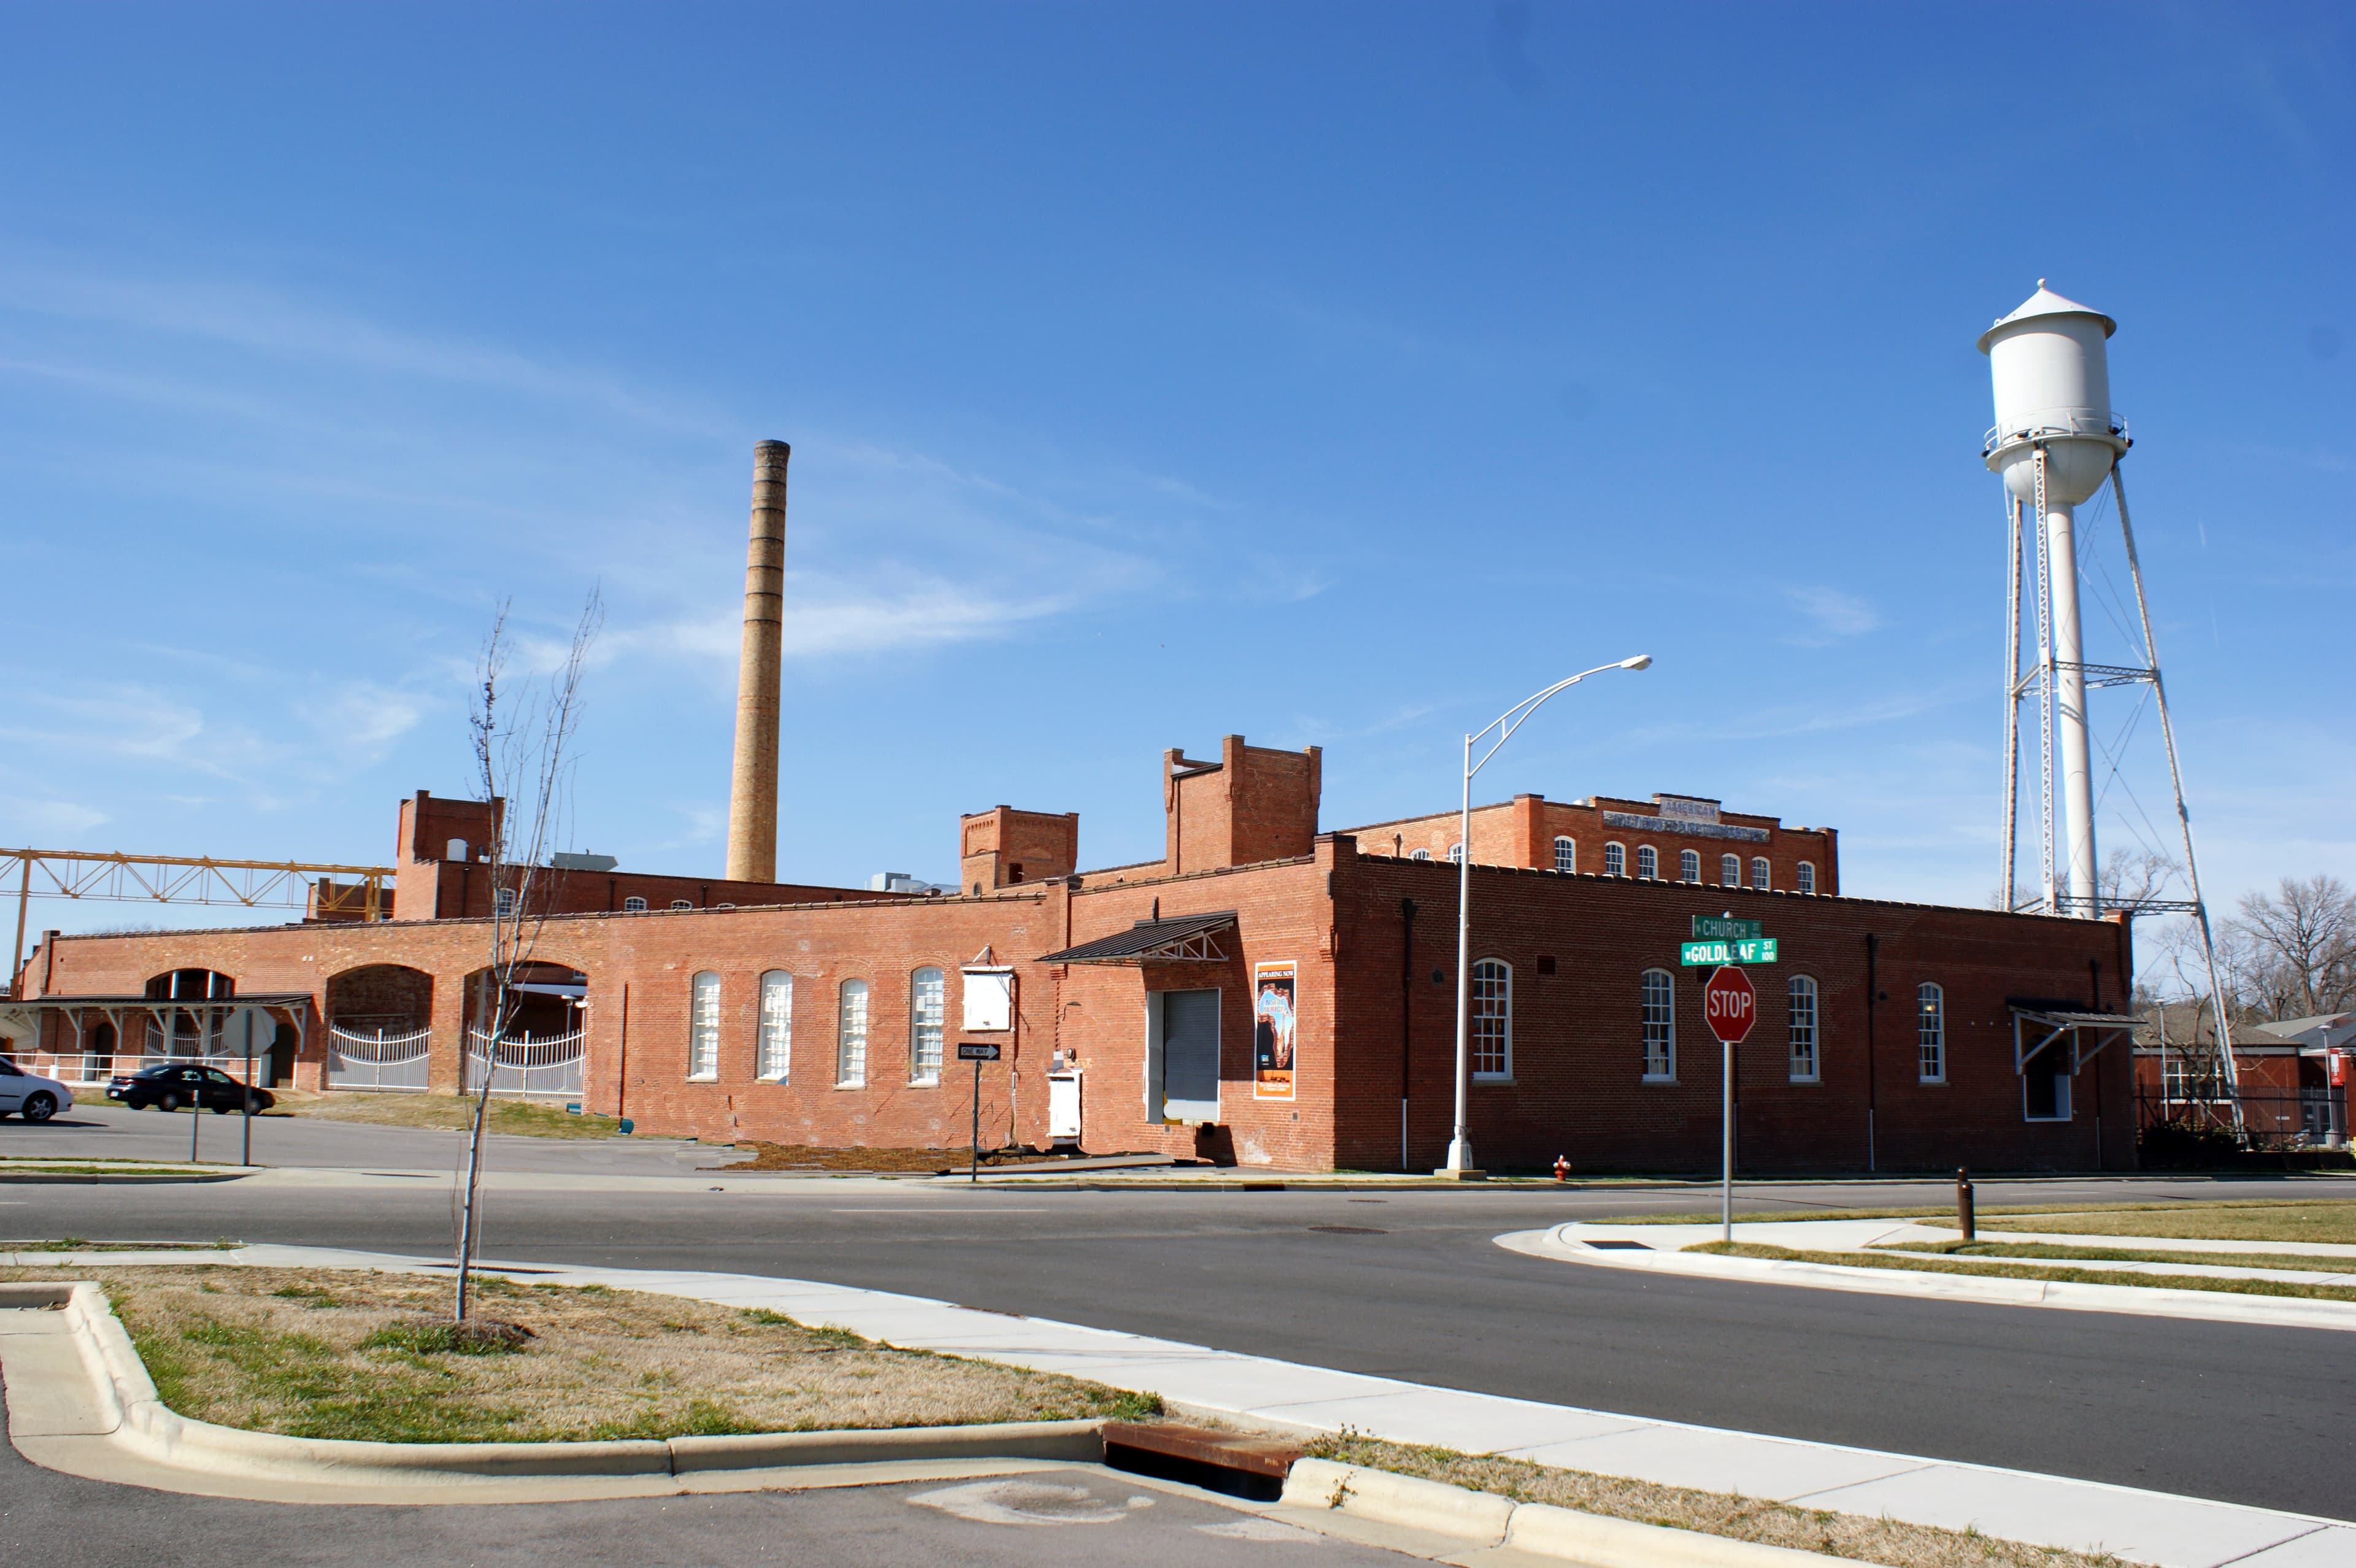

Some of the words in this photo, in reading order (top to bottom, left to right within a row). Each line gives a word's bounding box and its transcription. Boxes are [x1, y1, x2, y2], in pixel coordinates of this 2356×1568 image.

[1665, 801, 1716, 816] AMERICAN
[1703, 920, 1746, 938] CHURCH
[1692, 943, 1756, 962] GOLDLEAF
[1763, 941, 1773, 950] ST
[1762, 952, 1775, 961] 100
[1710, 990, 1751, 1018] STOP
